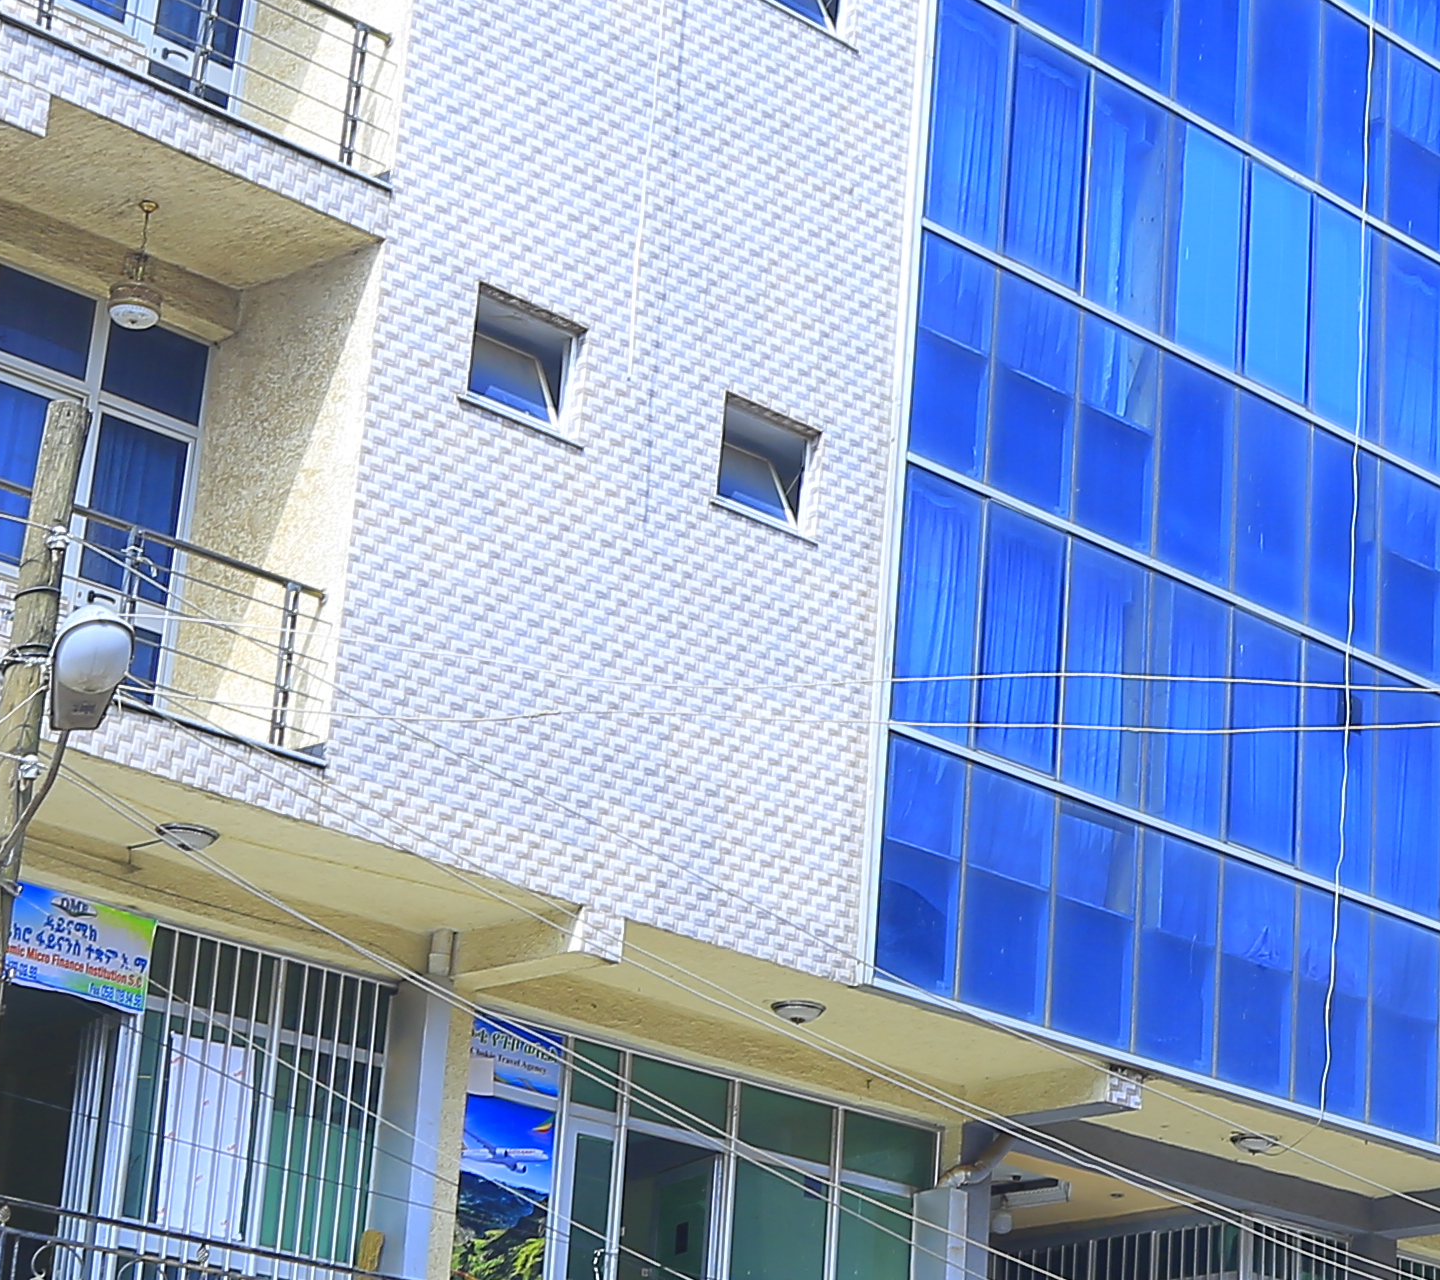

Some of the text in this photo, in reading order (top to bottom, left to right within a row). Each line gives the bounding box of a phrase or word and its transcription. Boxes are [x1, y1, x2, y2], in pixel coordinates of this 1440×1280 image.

[26, 947, 50, 965] Micro
[52, 954, 84, 972] Finance
[86, 963, 126, 985] Institution
[497, 1054, 521, 1067] Travel
[521, 1062, 547, 1074] Agency
